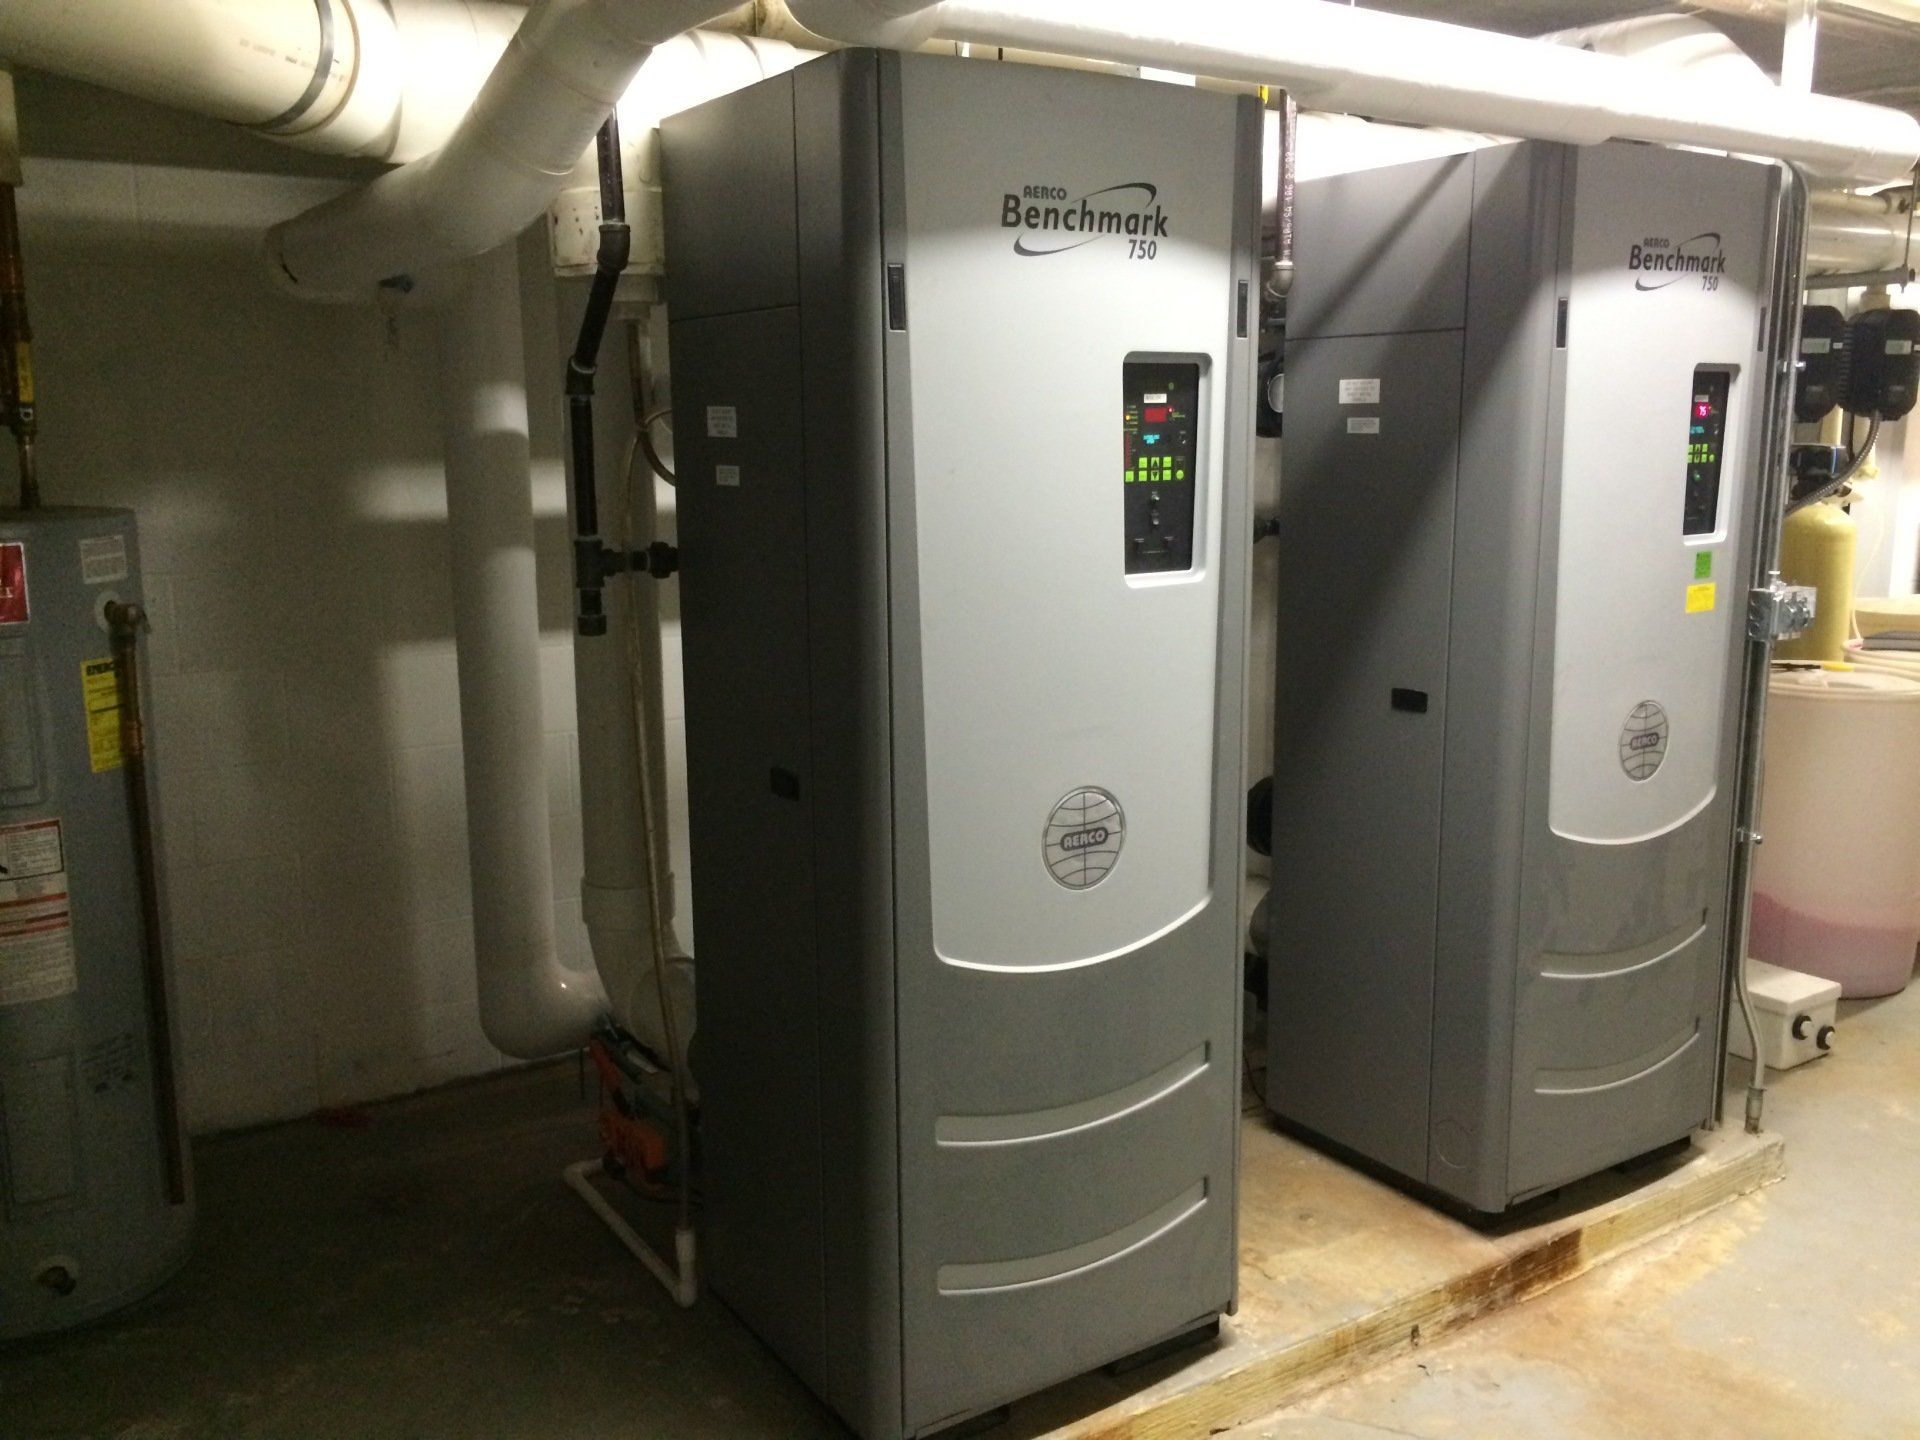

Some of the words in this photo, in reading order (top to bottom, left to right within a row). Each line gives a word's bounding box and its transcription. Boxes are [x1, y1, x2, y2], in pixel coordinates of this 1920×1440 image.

[1023, 185, 1067, 201] AERCO
[1001, 194, 1168, 237] Benchmark
[1128, 239, 1157, 260] 750
[1629, 245, 1726, 273] Benchmark
[1702, 275, 1718, 291] 750
[1063, 830, 1106, 848] AERCO
